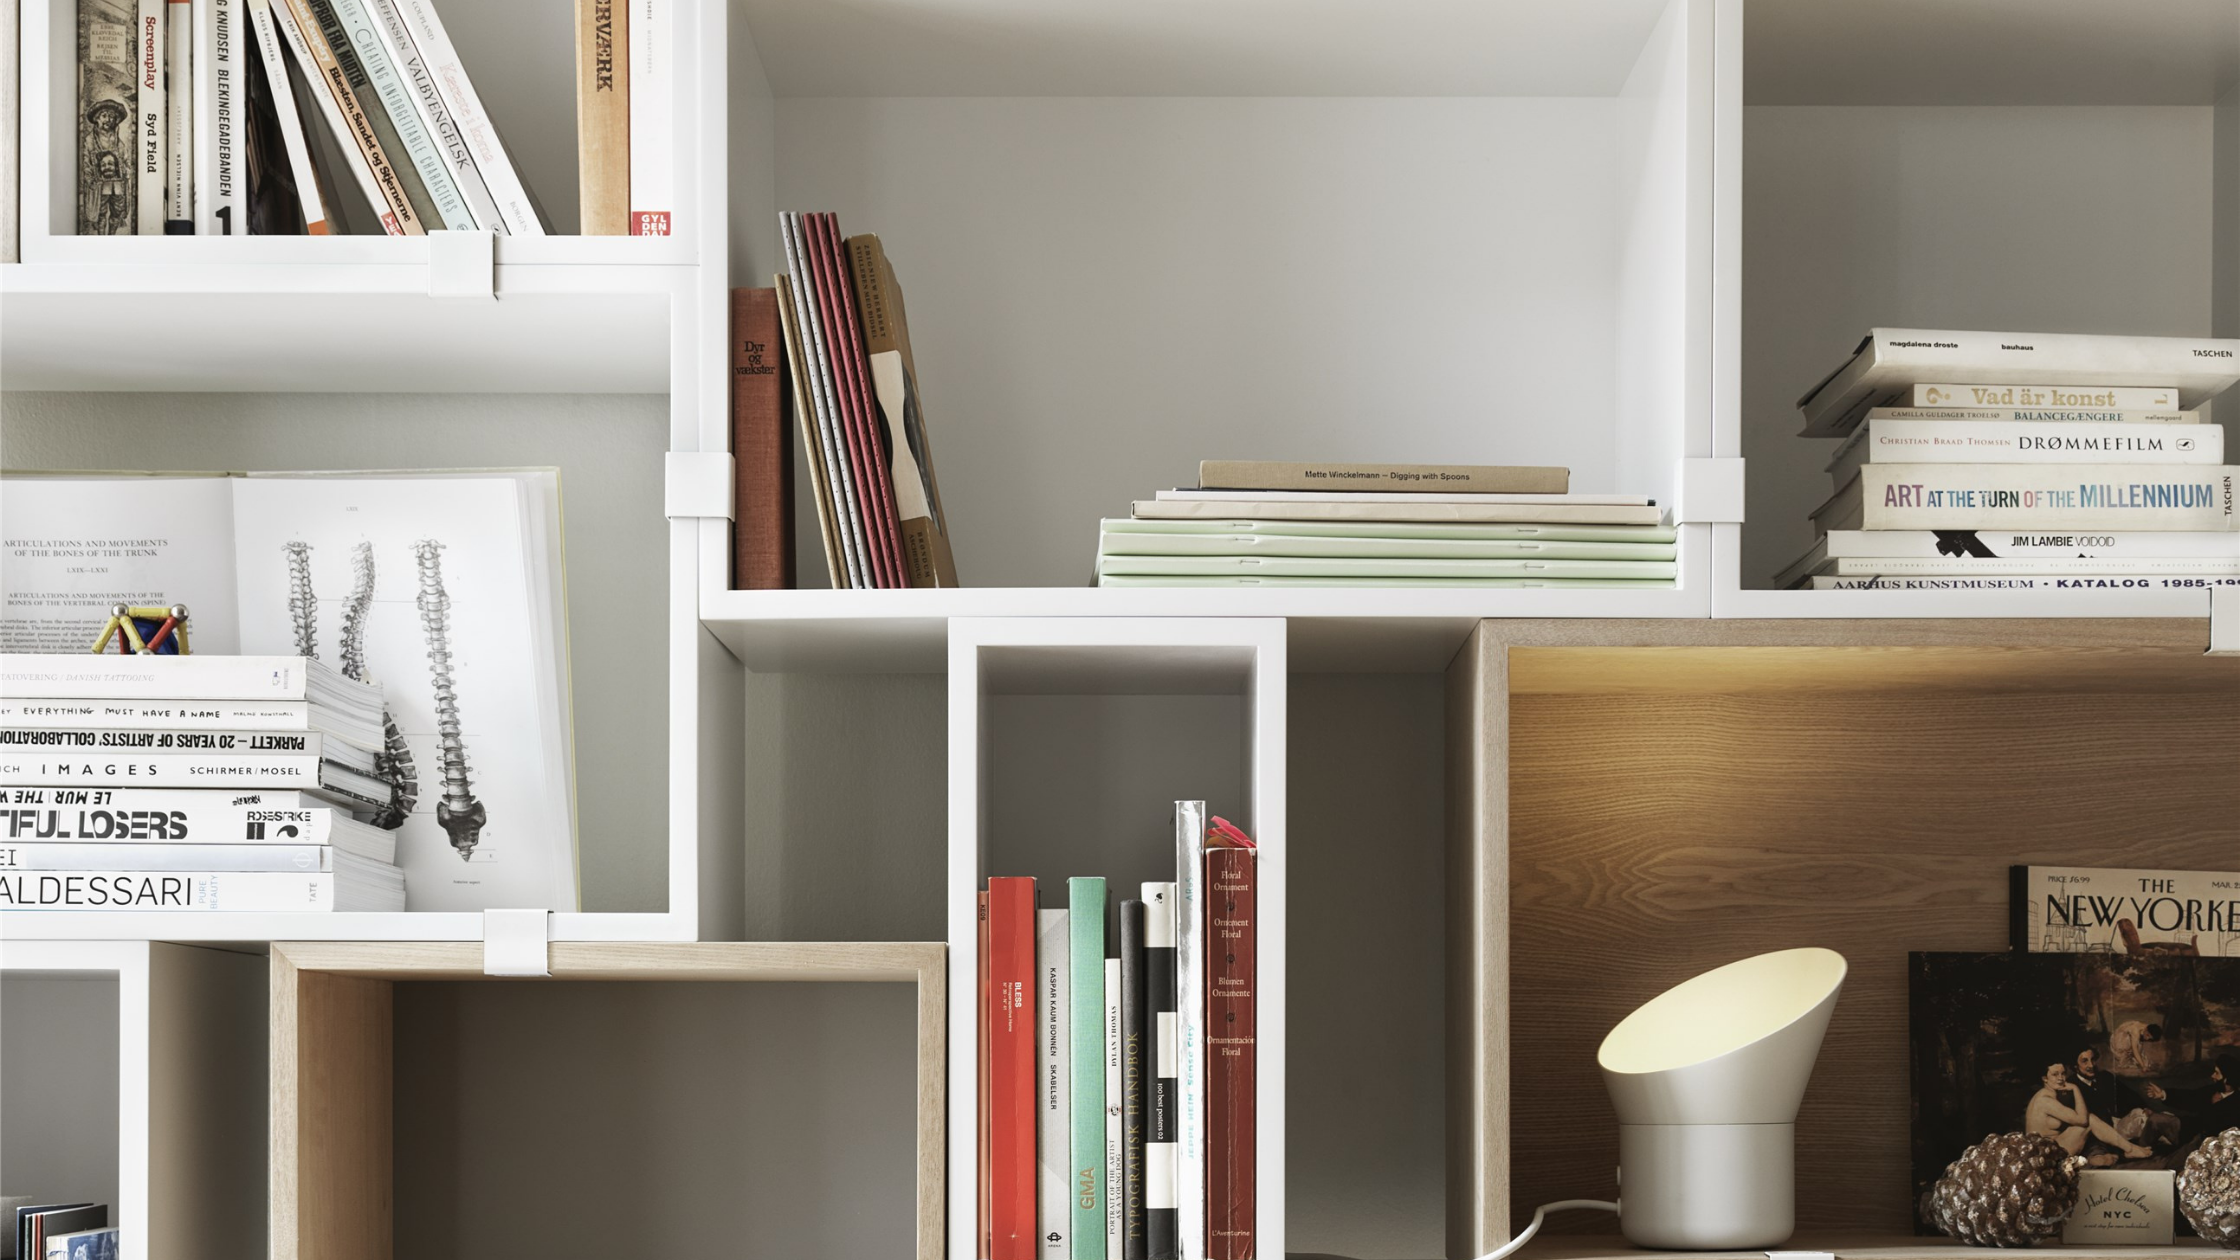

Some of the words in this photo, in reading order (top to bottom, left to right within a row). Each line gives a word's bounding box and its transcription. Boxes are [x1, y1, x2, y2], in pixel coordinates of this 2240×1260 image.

[217, 10, 229, 62] KNUDSEN
[144, 16, 157, 90] Screenplay
[327, 30, 345, 51] FRA
[337, 50, 367, 89] MIDTEN
[355, 28, 390, 81] CREATING
[382, 83, 427, 154] UNFORGETTABLE
[419, 155, 458, 213] CHARACTERS
[407, 57, 470, 170] VALBYENGELSK
[146, 113, 157, 137] Syd
[217, 69, 232, 197] BLEKINGEGADEBANDEN
[329, 66, 354, 114] Blæsten,
[352, 112, 374, 151] Sandet
[372, 152, 383, 167] og
[380, 166, 411, 223] Stjernerne
[147, 140, 157, 173] Field
[641, 214, 667, 223] GYL
[642, 223, 667, 231] DEN
[856, 245, 868, 290] STILLEBEN
[863, 291, 872, 309] MED
[864, 244, 878, 291] ZBIGNIEW
[873, 294, 886, 338] HERBERT
[744, 341, 765, 354] Dyr
[1889, 340, 1932, 349] magdalena
[1933, 341, 1959, 349] droste
[2001, 343, 2034, 351] bauhaus
[2193, 349, 2233, 358] TASCHEN
[748, 355, 762, 365] og
[735, 364, 776, 375] vækster
[1971, 388, 2014, 405] Vad
[2019, 388, 2046, 406] är
[2051, 389, 2116, 407] konst
[2014, 411, 2124, 421] BALANCEGÆNGERE
[2019, 436, 2164, 451] DRØMMEFILM
[1305, 471, 1327, 479] Mette
[1329, 471, 1380, 479] Winckelmann
[1390, 472, 1420, 481] Digging
[1422, 472, 1438, 480] with
[1440, 473, 1470, 481] Spoons
[1884, 484, 1924, 508] ART
[1927, 490, 1944, 508] AT
[1947, 490, 1976, 508] THE
[1979, 490, 2020, 508] TURN
[2023, 490, 2043, 508] OF
[2047, 490, 2076, 508] THE
[2079, 484, 2214, 508] MILLENNIUM
[2223, 476, 2232, 517] TASCHEN
[3, 540, 82, 548] ARTICULATIONS
[108, 539, 168, 547] MOVEMENTS
[2011, 536, 2029, 547] JIM
[2031, 536, 2074, 547] LAMBIE
[1833, 580, 1901, 590] AARHUS
[1906, 580, 2034, 589] KUNSTMUSEUM
[2057, 579, 2150, 588] KATALOG
[104, 674, 155, 682] TATTOOING
[23, 707, 95, 716] EVERYTHING
[105, 708, 134, 716] MUST
[142, 710, 171, 718] HAVE
[179, 710, 186, 718] A
[157, 733, 173, 748] OF
[176, 734, 216, 748] YEARS
[219, 735, 235, 749] 20
[249, 735, 305, 750] PARKETT
[42, 764, 157, 775] IMAGES
[190, 767, 301, 775] SCHIRMER/MOSEL
[14, 790, 43, 804] THE
[55, 790, 88, 805] MUR
[93, 791, 112, 805] LE
[78, 810, 188, 840] LOSERS
[1221, 871, 1241, 880] Floral
[2047, 875, 2067, 884] PRICE
[198, 880, 207, 904] PURE
[210, 874, 218, 909] BEAUTY
[309, 882, 317, 902] TATE
[1214, 883, 1249, 891] Ornament
[2138, 878, 2175, 893] THE
[2047, 894, 2124, 928] NEW
[2130, 897, 2240, 932] YORKE
[1214, 918, 1249, 926] Ornement
[1221, 930, 1241, 938] Floral
[1218, 977, 1244, 985] Blumen
[1014, 982, 1022, 1008] BLESS
[1212, 989, 1251, 997] Ornamente
[1050, 1024, 1058, 1057] BONNÉN
[1222, 1047, 1241, 1056] Floral
[1127, 1031, 1139, 1115] HANDBOK
[1157, 1108, 1165, 1131] posters
[1157, 1132, 1164, 1140] 02
[1080, 1167, 1096, 1210] GMA
[1127, 1124, 1141, 1240] TYPOGRAFISK
[1109, 1186, 1115, 1196] OF
[2084, 1187, 2113, 1215] Hotel
[2115, 1187, 2150, 1214] Chelsea
[1115, 1210, 1122, 1220] AS
[2103, 1211, 2132, 1219] NYC
